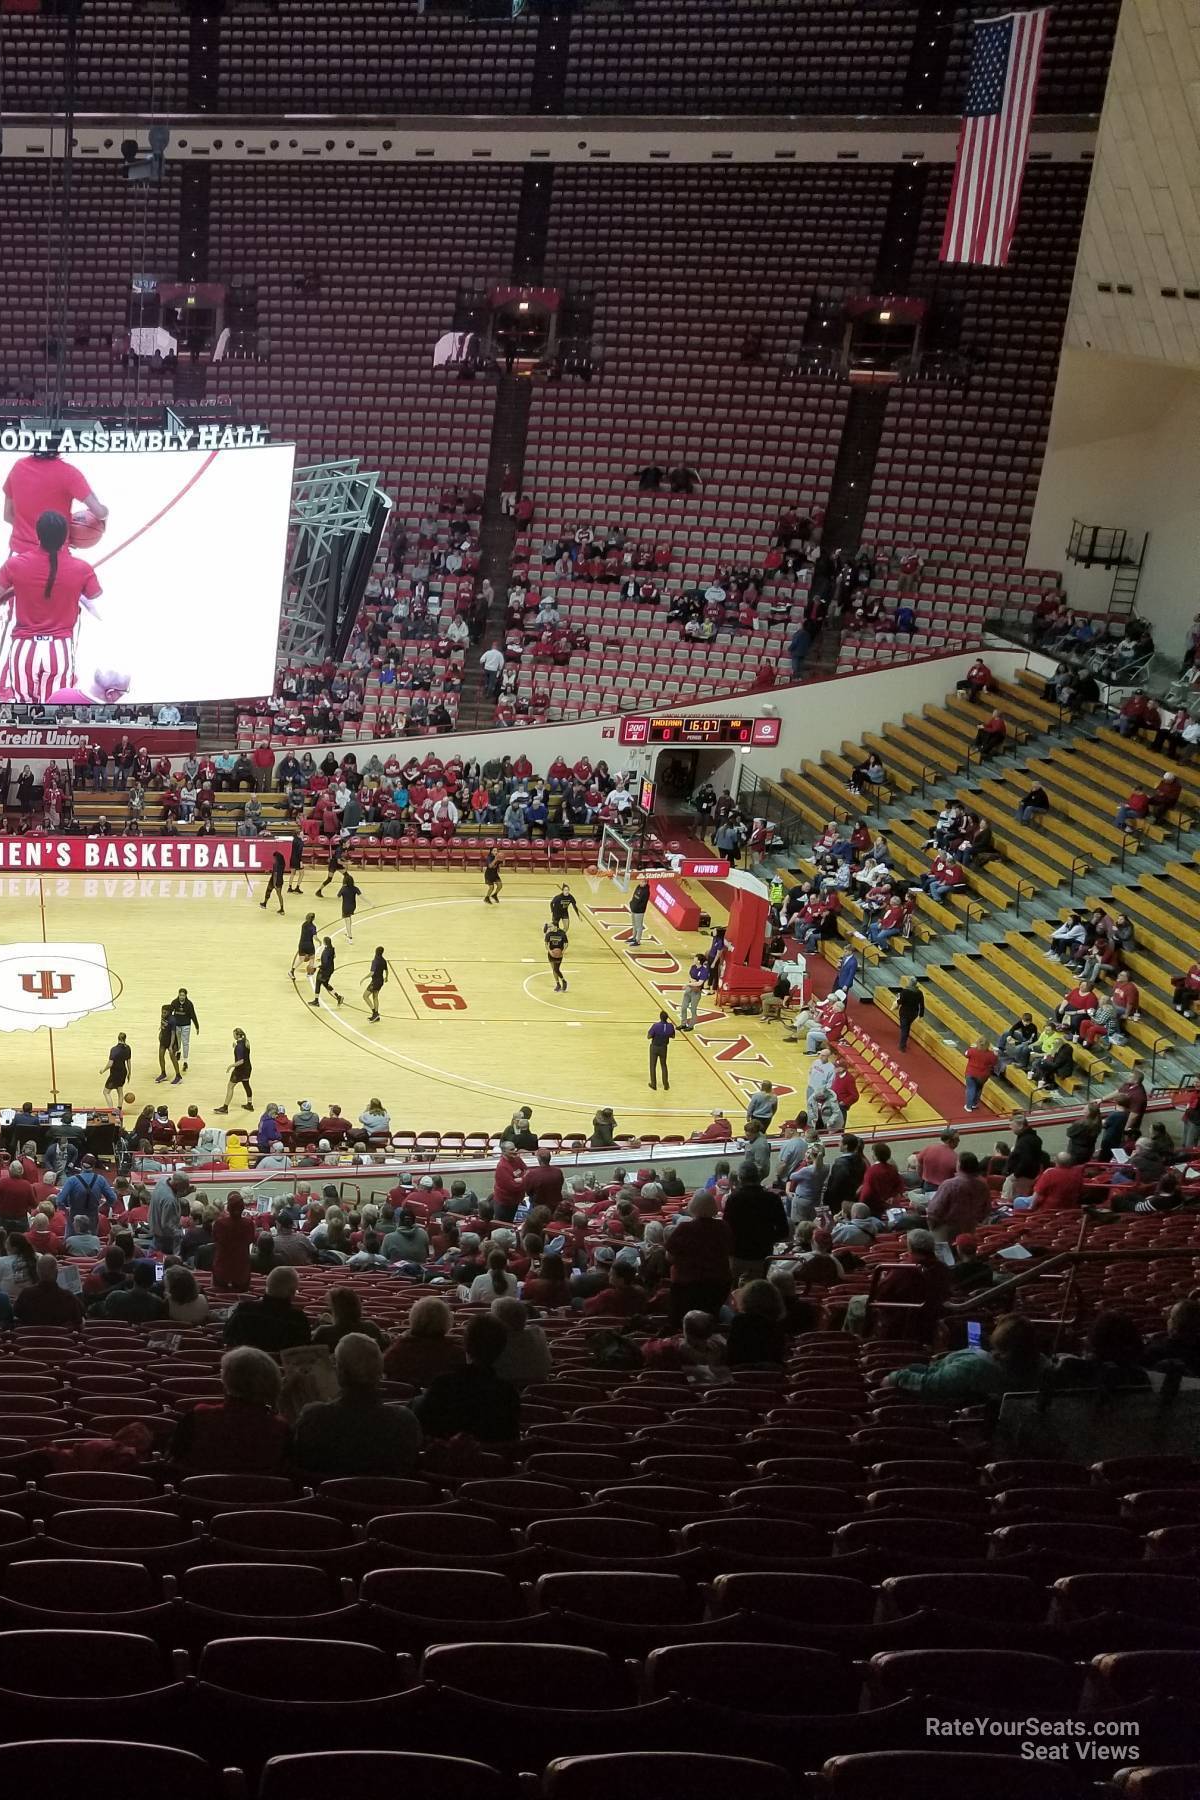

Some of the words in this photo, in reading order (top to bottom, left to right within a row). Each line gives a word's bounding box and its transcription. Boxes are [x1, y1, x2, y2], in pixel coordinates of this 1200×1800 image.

[57, 427, 194, 452] ASSEMBLY
[197, 424, 265, 450] HALL
[652, 719, 683, 727] INDIANA
[689, 720, 718, 731] 16:07
[46, 730, 89, 745] Union
[662, 728, 670, 740] 0
[740, 729, 748, 740] 0
[85, 843, 262, 868] BASKETBALL
